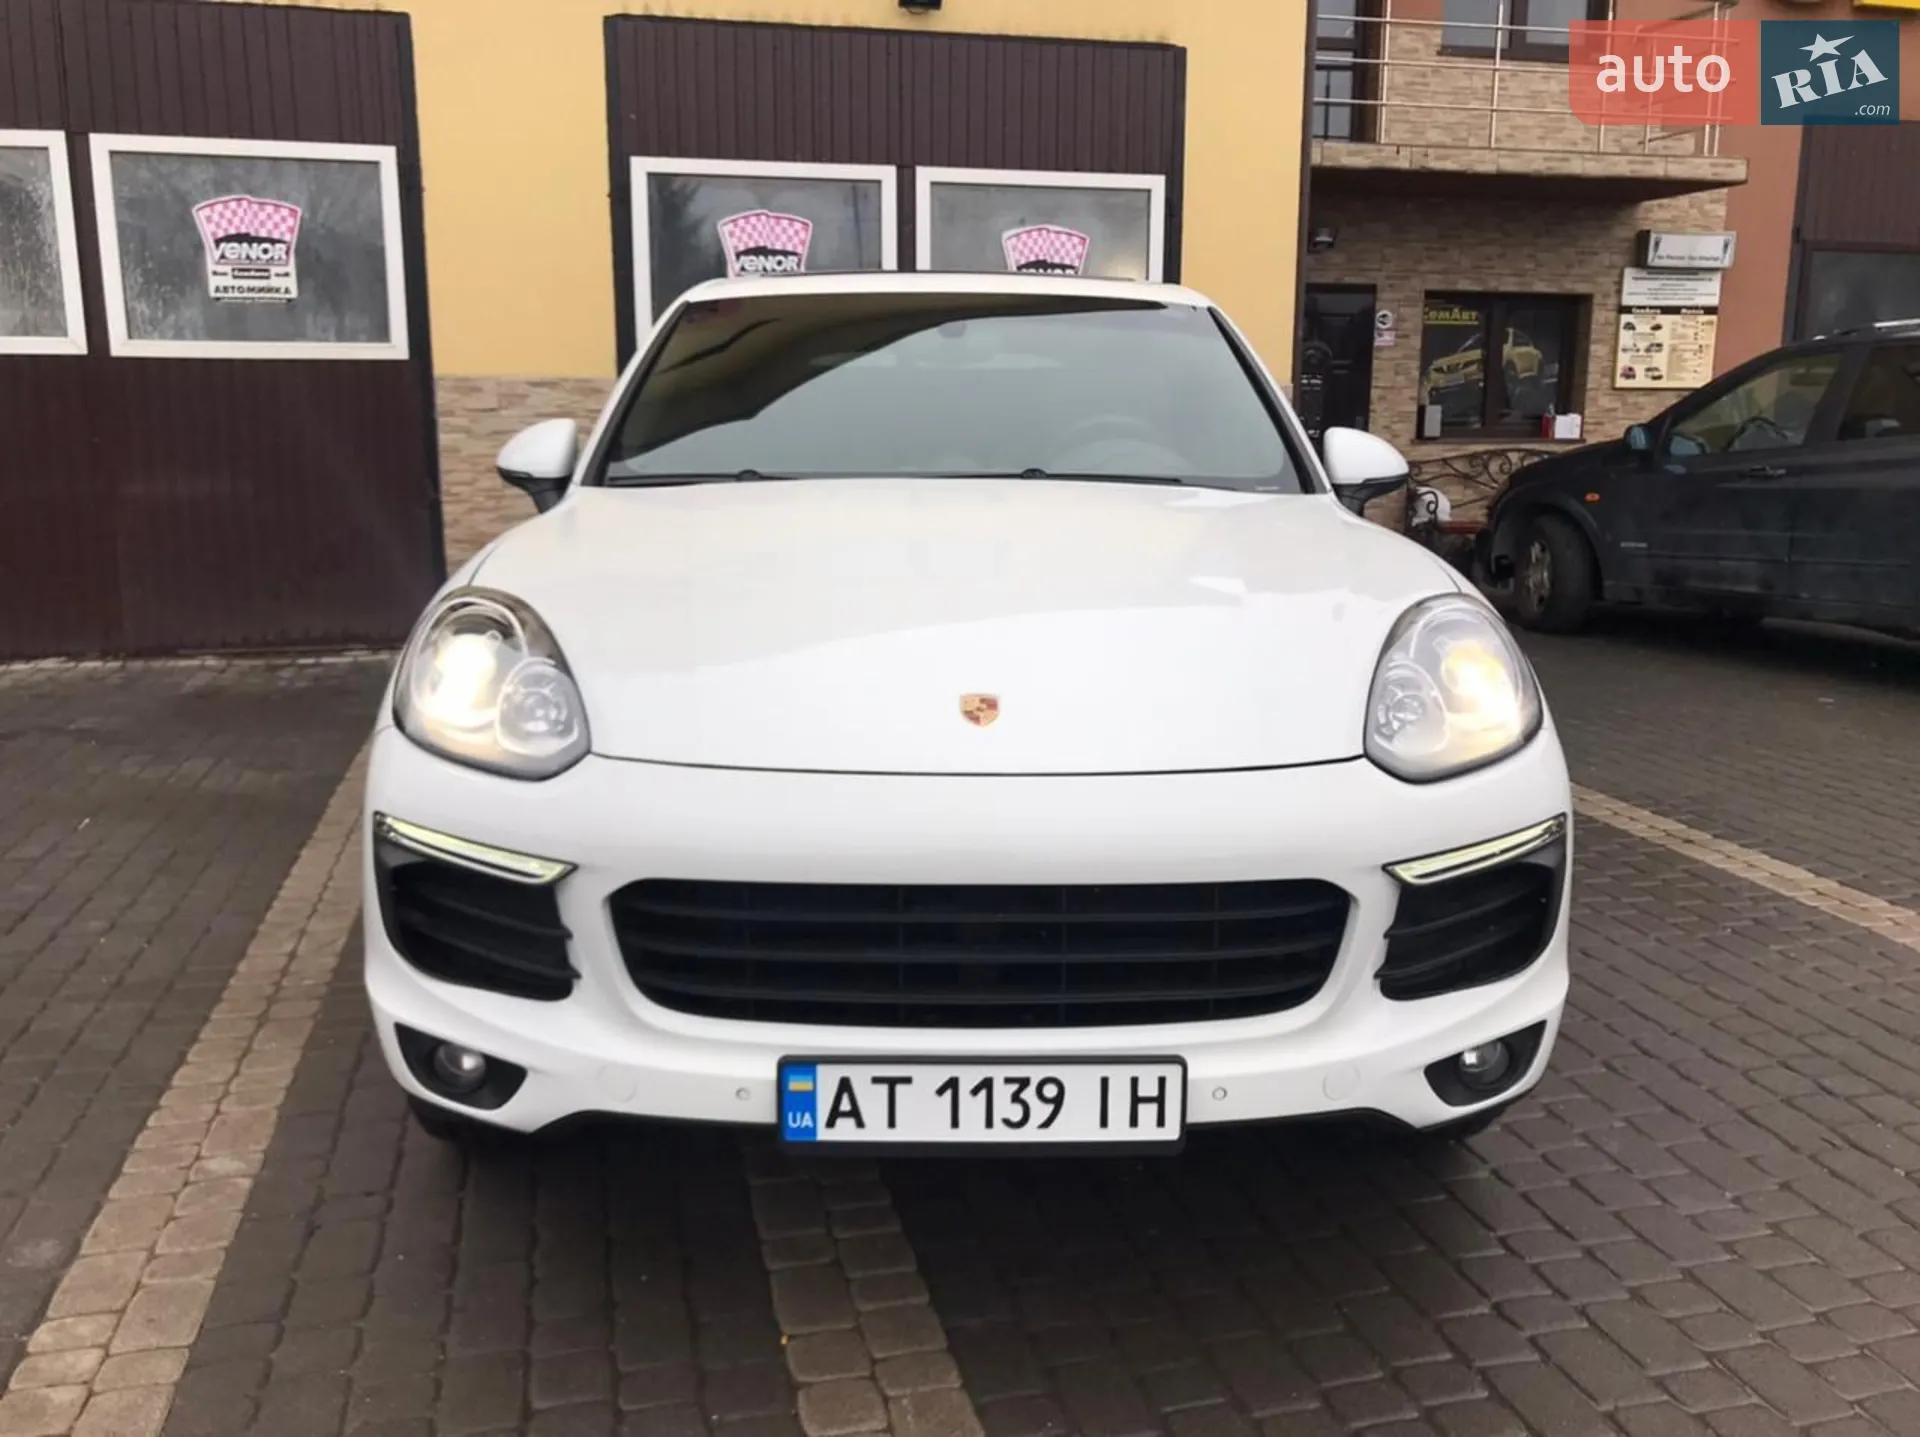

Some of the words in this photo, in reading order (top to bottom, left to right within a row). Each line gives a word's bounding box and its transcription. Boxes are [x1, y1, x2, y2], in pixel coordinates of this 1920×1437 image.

[824, 1076, 913, 1129] AT
[935, 1076, 1066, 1129] 1139
[1099, 1075, 1167, 1129] IH
[788, 1112, 814, 1128] UA
